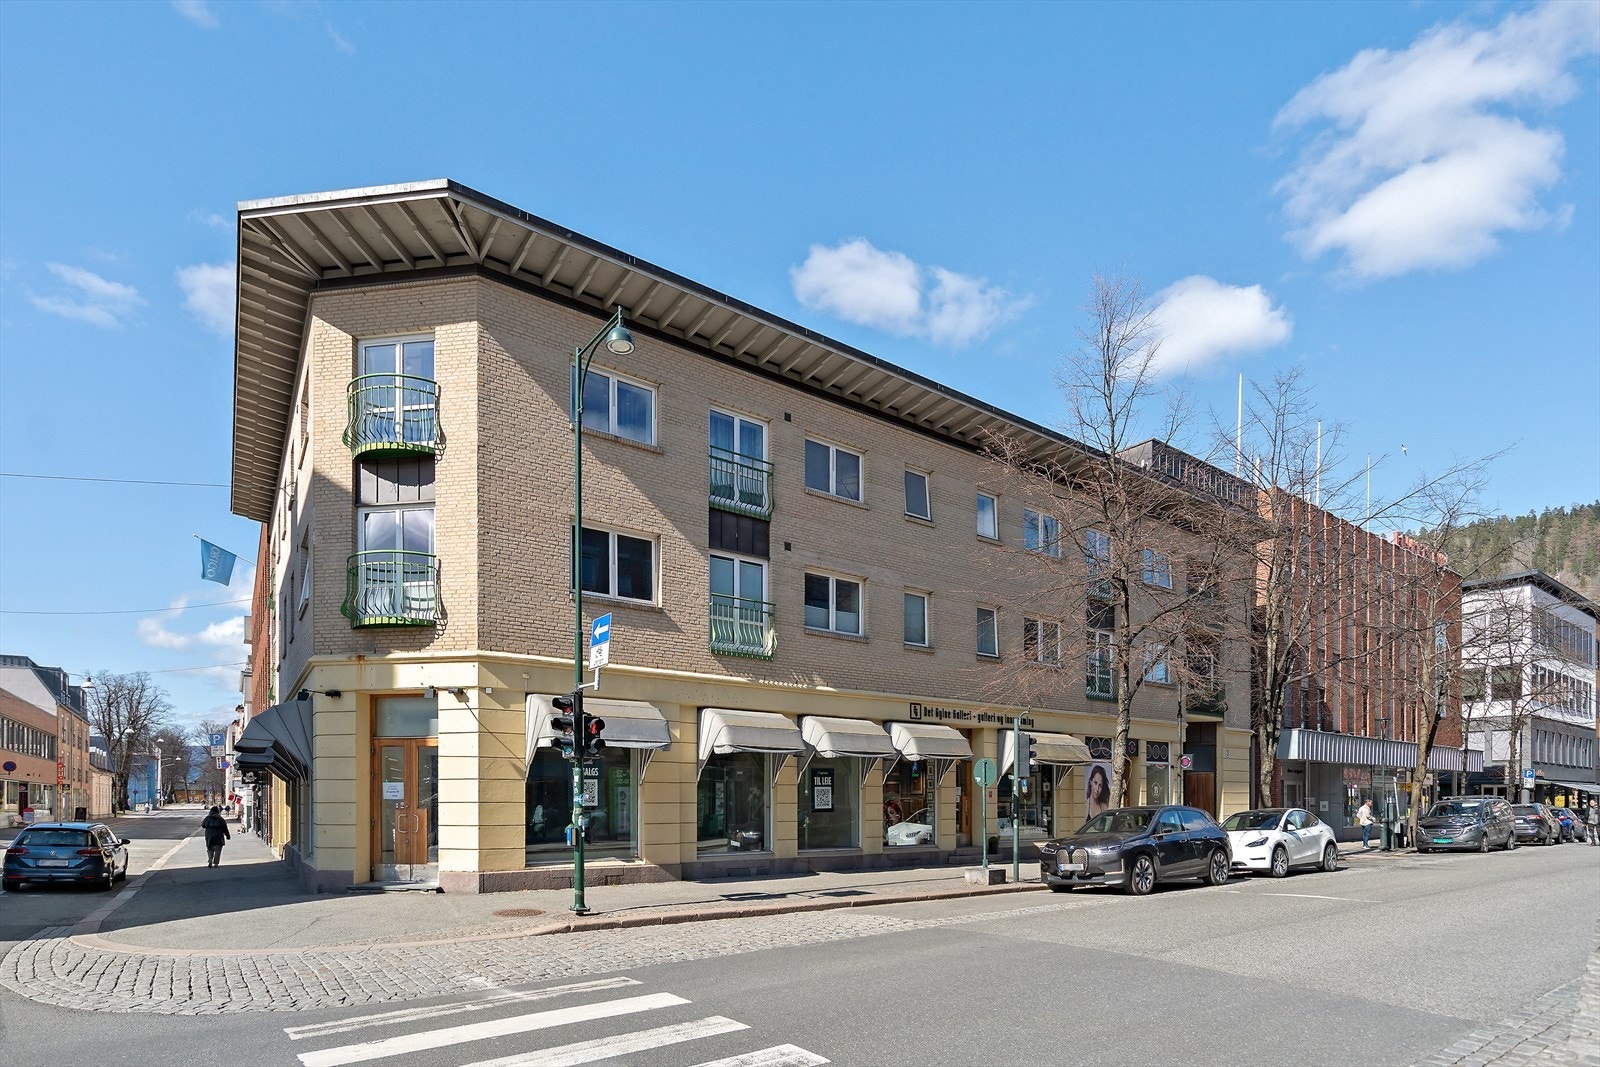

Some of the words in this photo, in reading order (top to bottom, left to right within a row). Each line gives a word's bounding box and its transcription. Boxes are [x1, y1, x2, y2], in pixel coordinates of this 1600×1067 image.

[924, 706, 934, 717] Det
[952, 709, 972, 721] Galleri
[977, 712, 996, 724] galleri
[997, 715, 1004, 725] og
[213, 734, 221, 745] P
[1526, 770, 1533, 778] P
[814, 776, 822, 785] TIL
